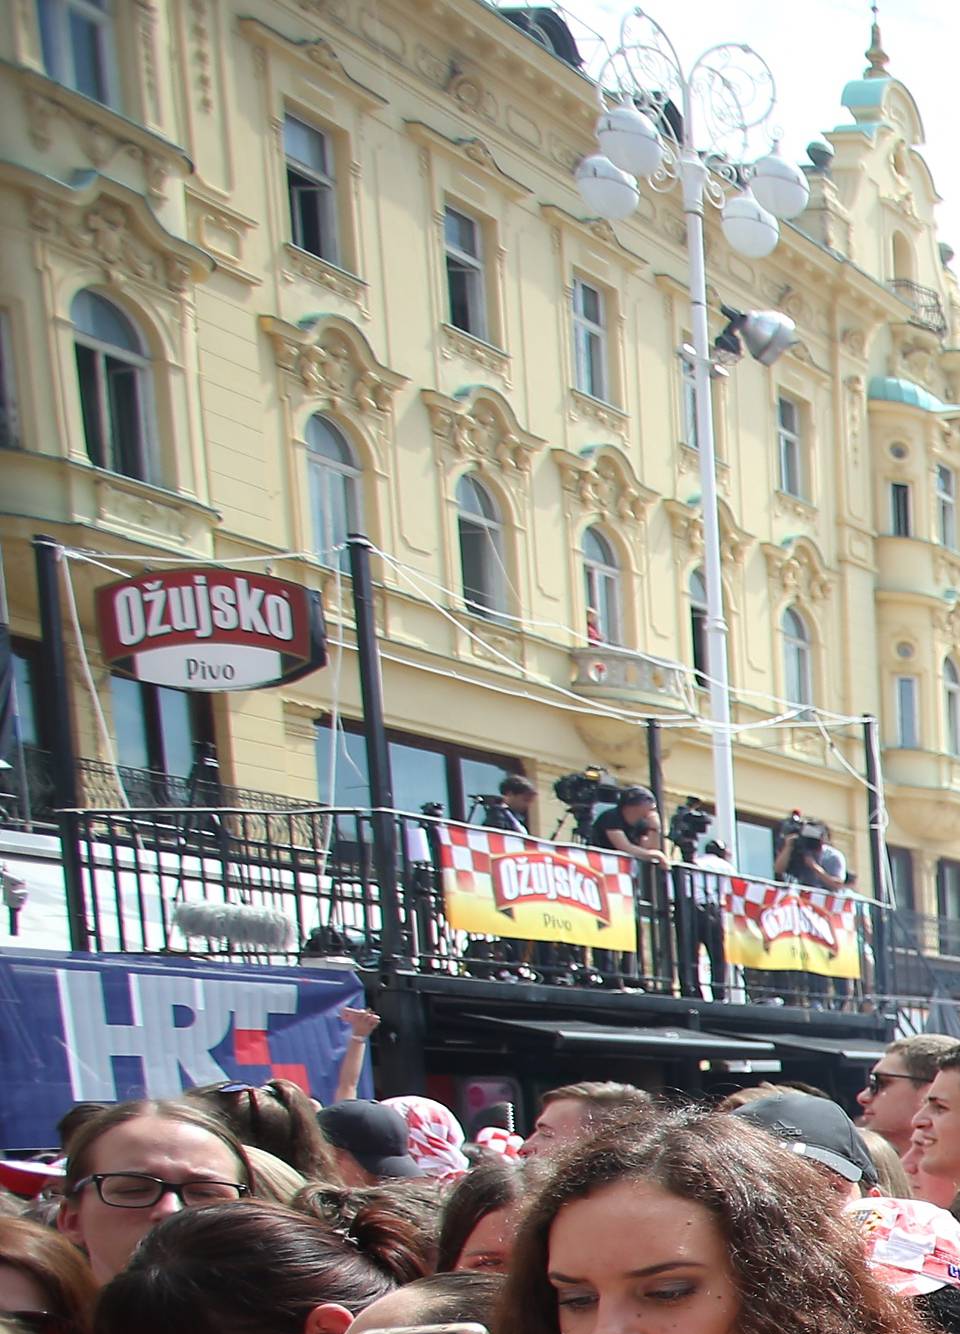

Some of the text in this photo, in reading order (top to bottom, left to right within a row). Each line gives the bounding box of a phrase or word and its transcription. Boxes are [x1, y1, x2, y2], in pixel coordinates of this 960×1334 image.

[114, 574, 294, 647] Ožujsko
[186, 658, 236, 681] Pivo
[499, 856, 602, 912] Ožujsko
[543, 913, 572, 932] Pivo
[55, 968, 299, 1102] HRT
